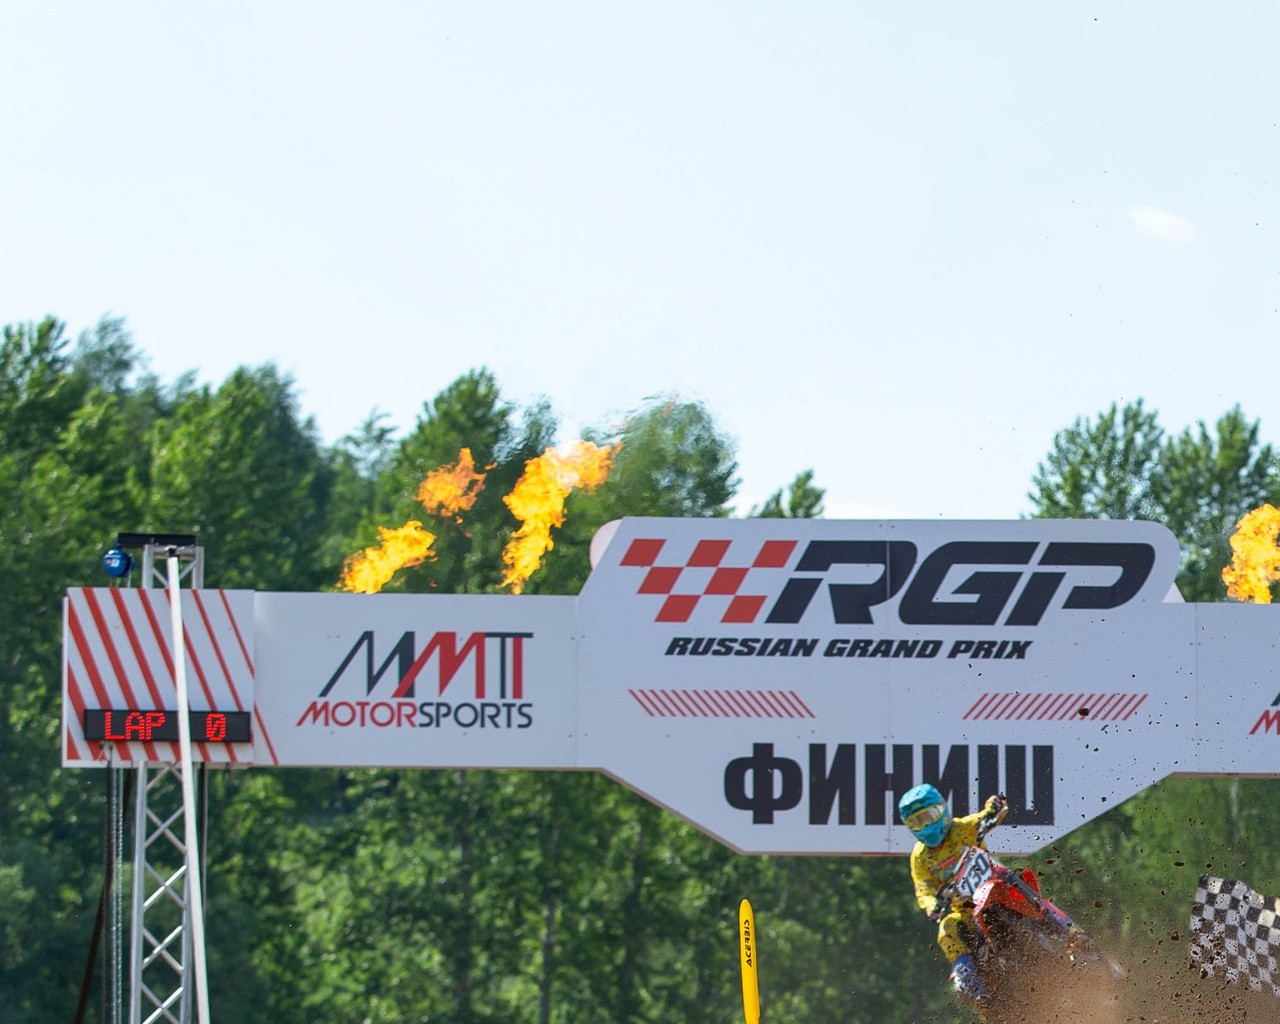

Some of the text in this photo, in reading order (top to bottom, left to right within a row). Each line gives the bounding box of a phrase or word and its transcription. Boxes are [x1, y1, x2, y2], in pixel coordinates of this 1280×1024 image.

[765, 540, 1156, 626] RGP
[665, 637, 1033, 660] RUSSIAN GRAND PRIX
[105, 712, 226, 741] LAP 0
[296, 701, 533, 728] MOTORSPORTS
[723, 743, 1054, 825] ФИНИШ
[744, 919, 752, 967] ACERBIS
